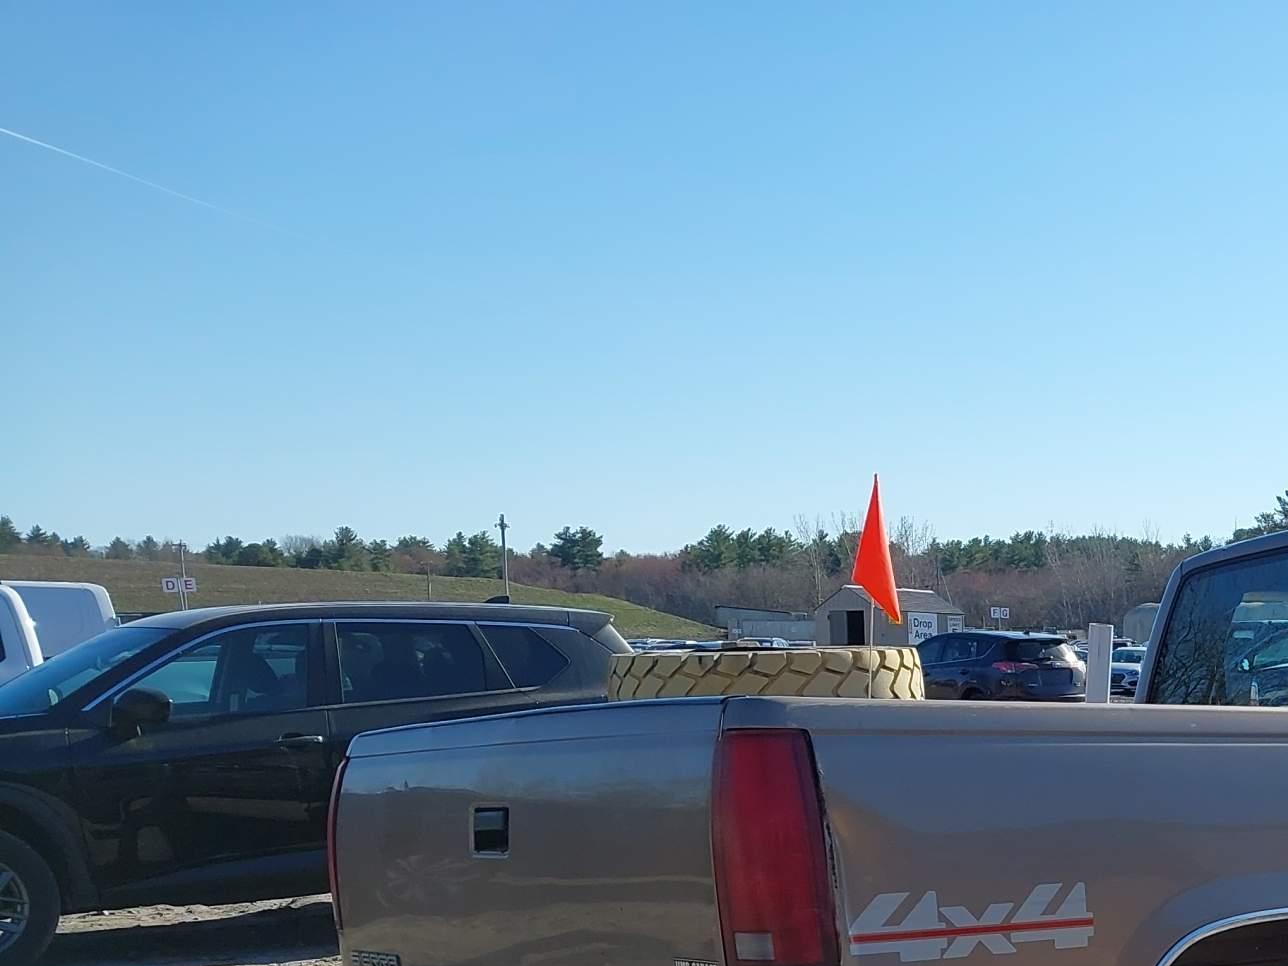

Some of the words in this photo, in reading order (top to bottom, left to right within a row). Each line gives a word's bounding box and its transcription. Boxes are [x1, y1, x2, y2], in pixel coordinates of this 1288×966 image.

[166, 580, 175, 590] D
[184, 580, 193, 590] E
[913, 617, 933, 630] Drop
